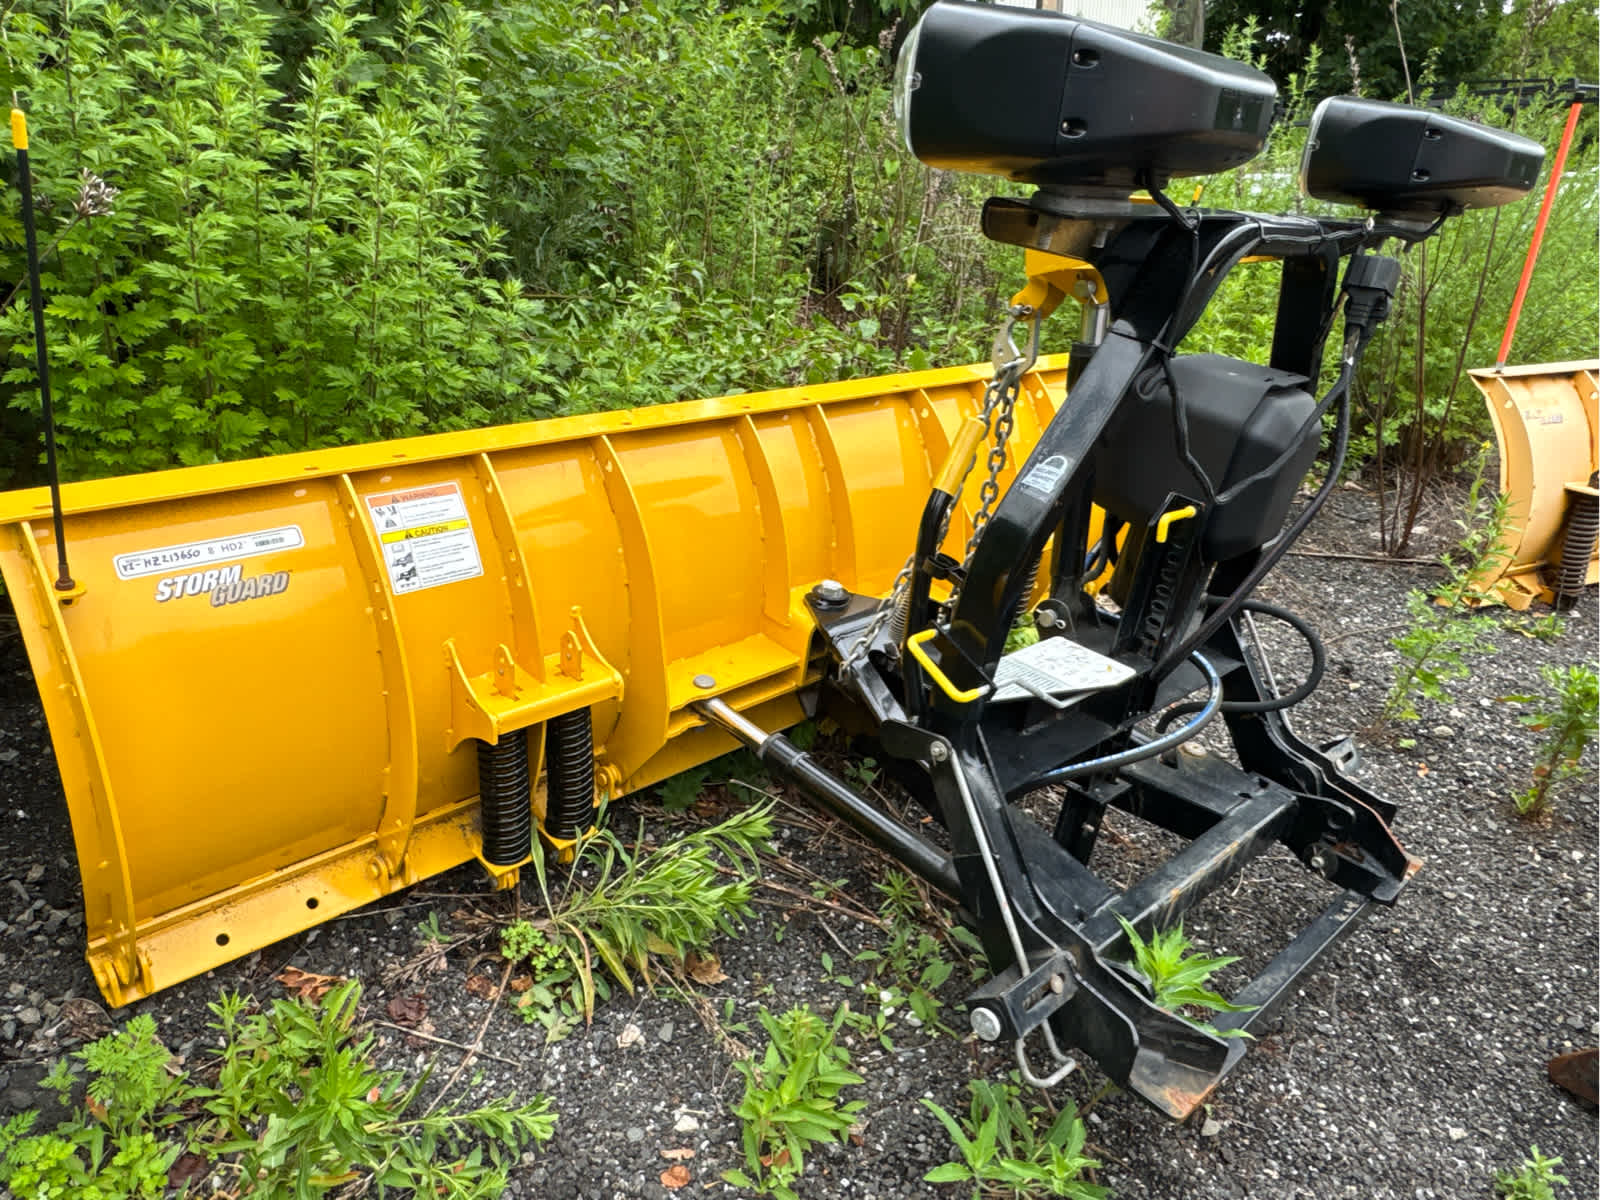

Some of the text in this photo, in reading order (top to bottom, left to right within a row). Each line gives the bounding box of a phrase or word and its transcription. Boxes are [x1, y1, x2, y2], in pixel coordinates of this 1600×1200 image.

[415, 525, 449, 537] CAUTION
[155, 565, 242, 602] STORM
[210, 571, 290, 607] GUARD
